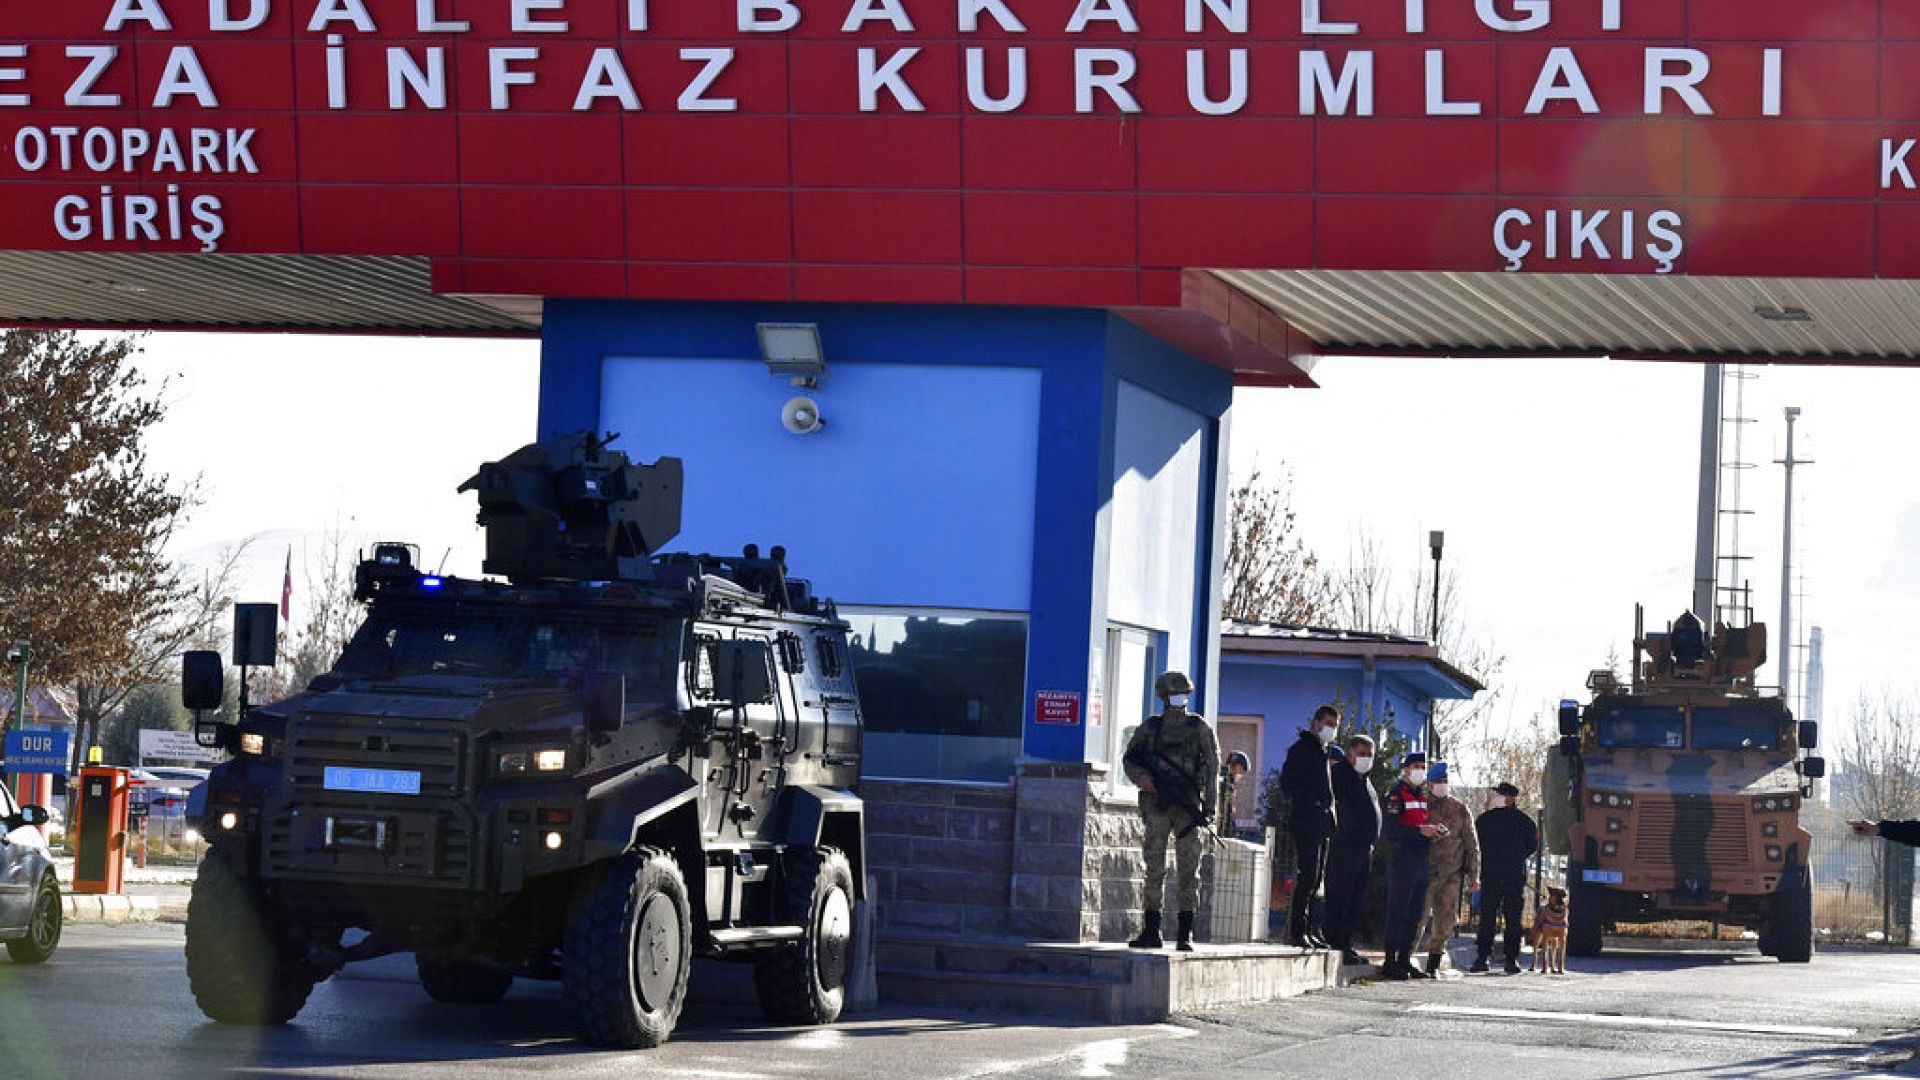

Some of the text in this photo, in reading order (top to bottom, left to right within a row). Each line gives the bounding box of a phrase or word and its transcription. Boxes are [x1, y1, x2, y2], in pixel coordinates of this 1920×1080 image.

[325, 33, 738, 112] İNFAZ
[857, 46, 1783, 117] KURUMLARI
[14, 125, 259, 174] OTOPARK
[53, 184, 226, 253] GİRİŞ
[1493, 207, 1684, 274] ÇIKIŞ
[22, 736, 52, 752] DUR
